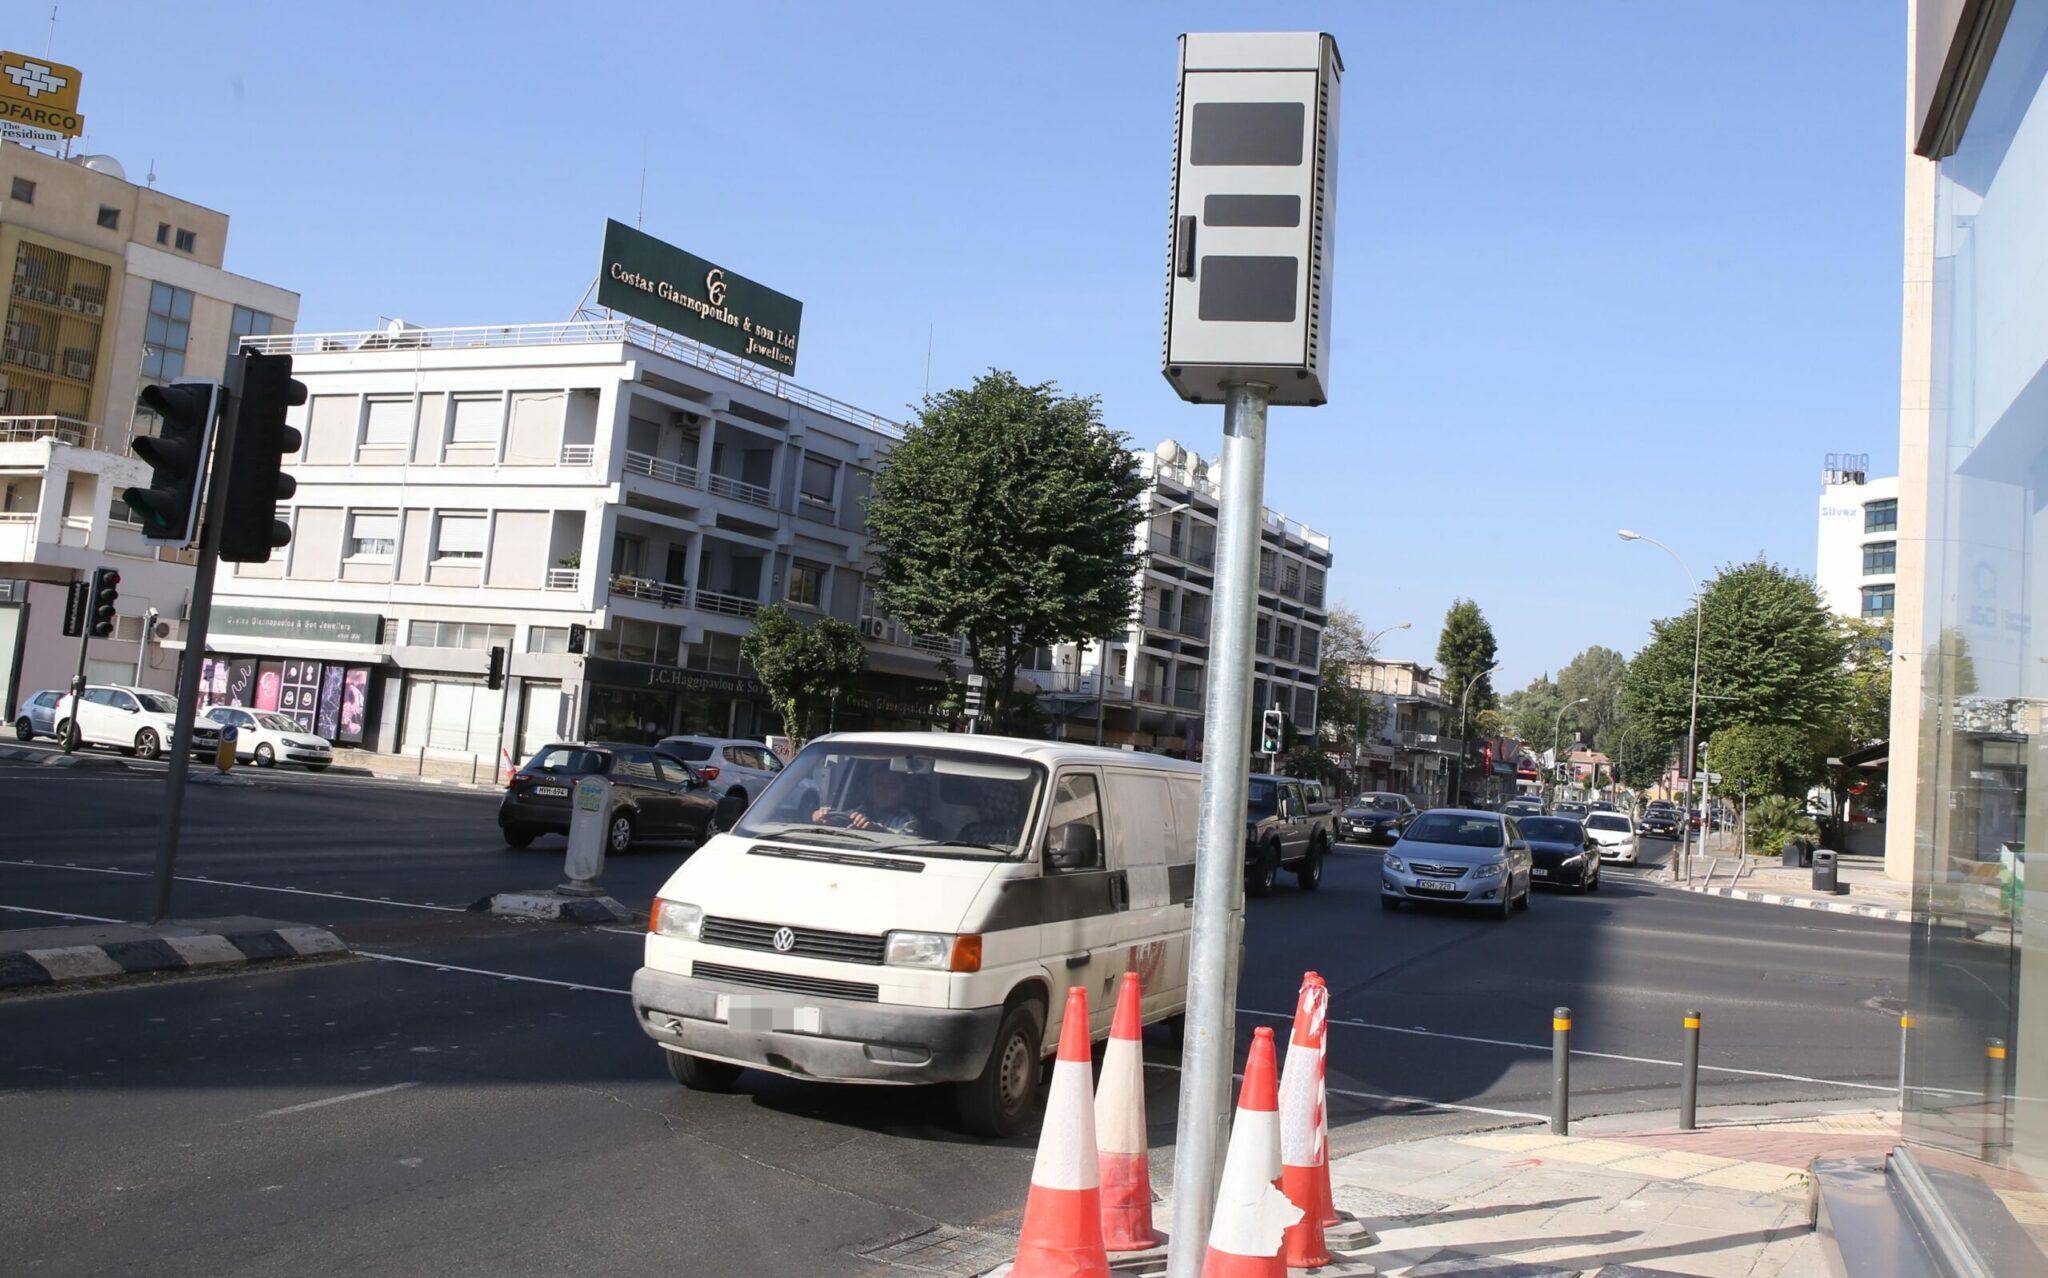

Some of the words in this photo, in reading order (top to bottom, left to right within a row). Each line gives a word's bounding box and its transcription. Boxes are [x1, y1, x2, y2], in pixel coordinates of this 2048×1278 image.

[0, 127, 57, 141] residium
[610, 261, 654, 294] Costas
[657, 280, 740, 328] Giannopoulos
[742, 316, 752, 332] &
[754, 324, 774, 343] son
[777, 328, 796, 350] Ltd
[745, 337, 794, 366] Jewellers
[736, 680, 745, 692] &
